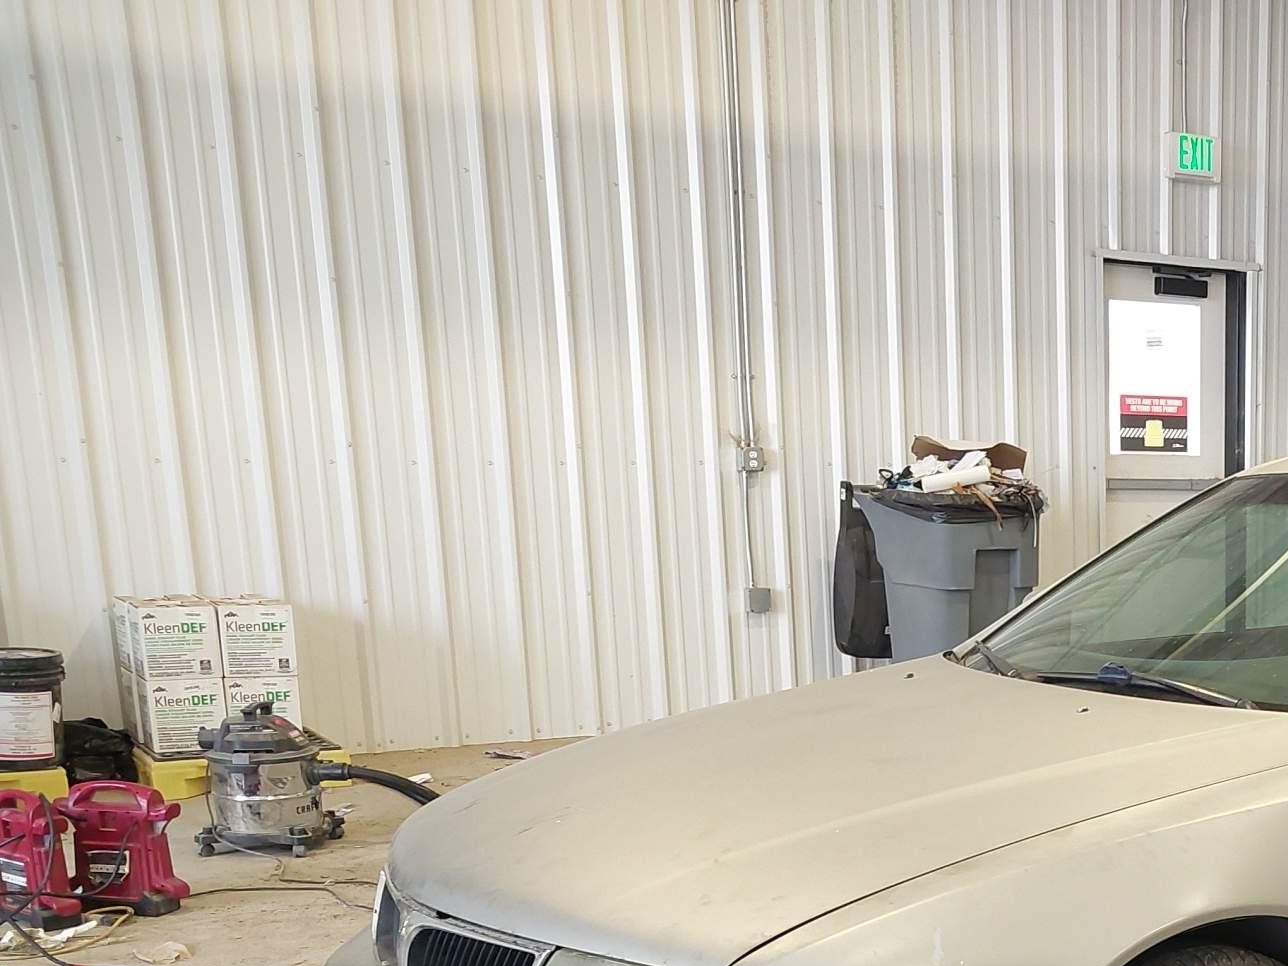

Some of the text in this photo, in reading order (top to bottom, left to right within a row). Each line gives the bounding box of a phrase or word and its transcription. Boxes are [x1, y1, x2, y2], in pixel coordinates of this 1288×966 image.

[1179, 135, 1214, 172] EXIT
[144, 621, 207, 635] KleenDEF
[225, 620, 288, 634] KleenDEF
[154, 693, 217, 708] KleenDEF
[230, 689, 291, 704] KleenDEF
